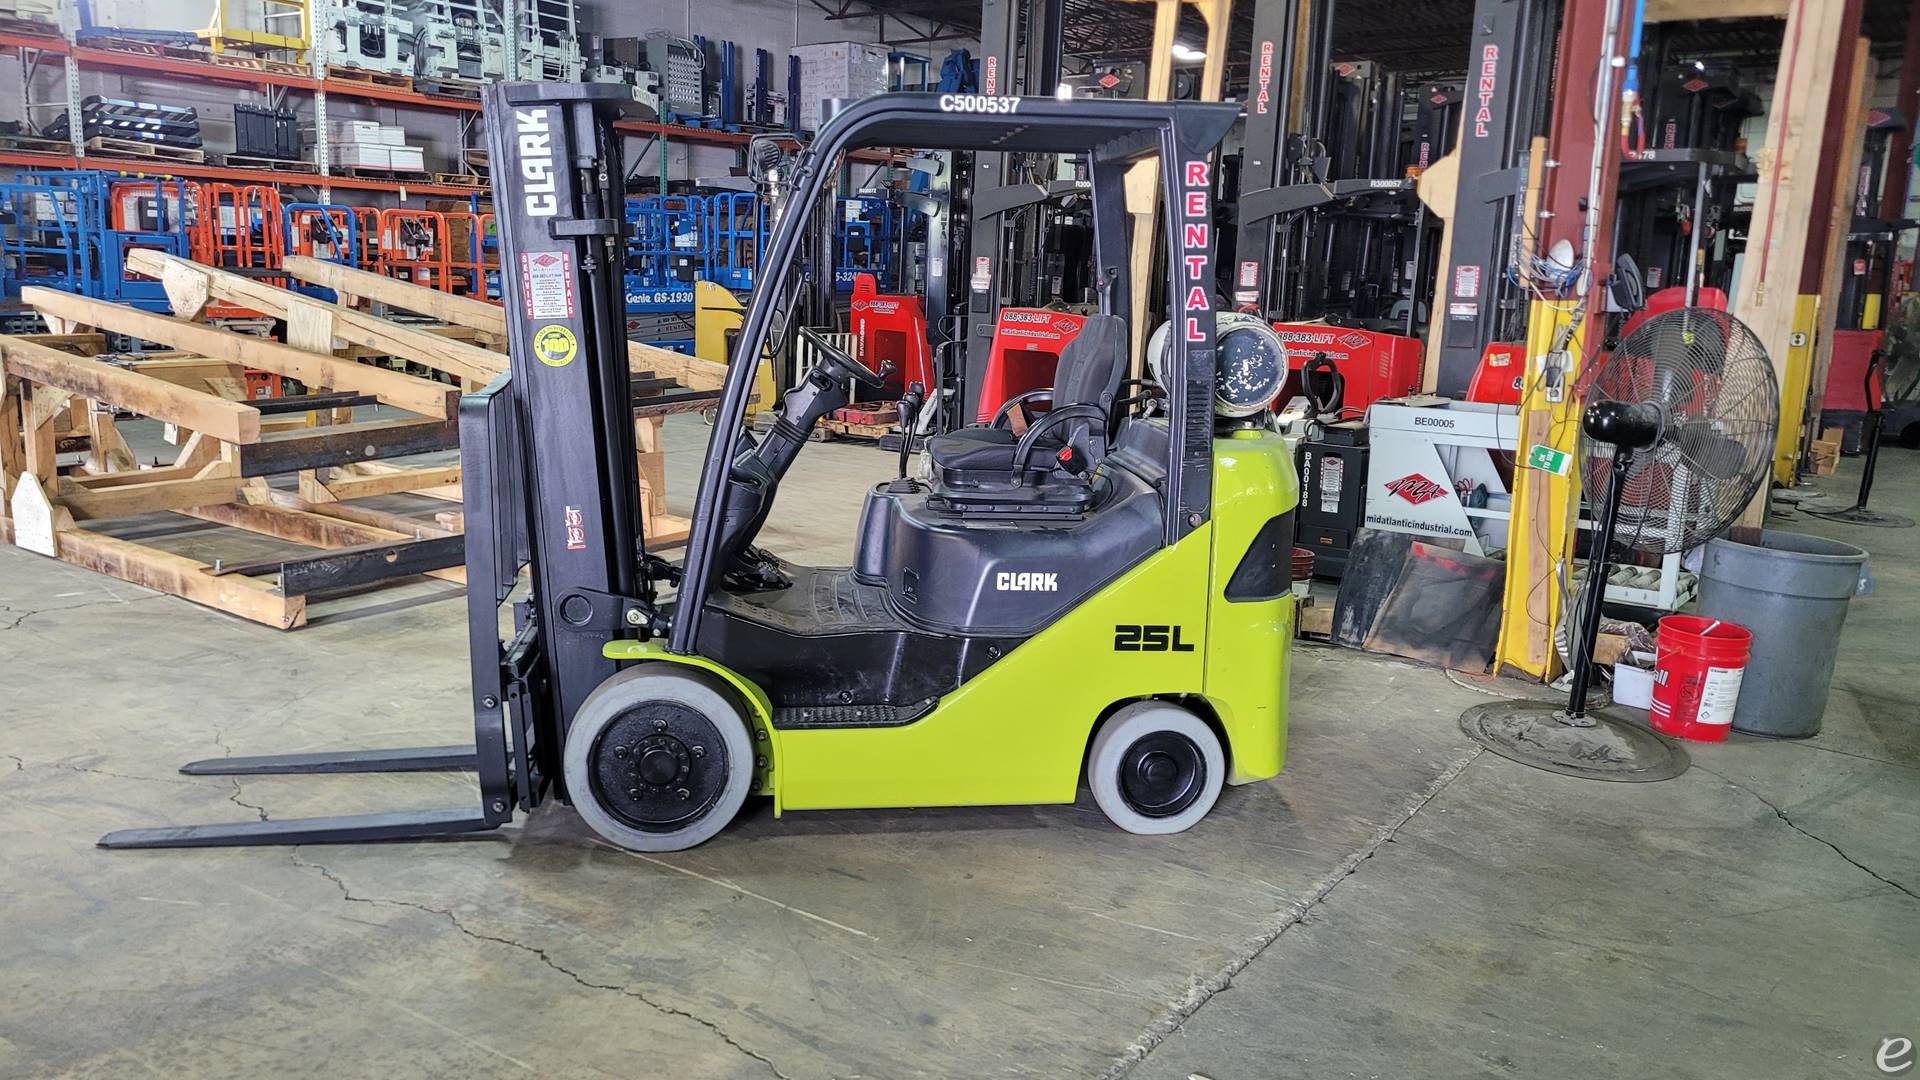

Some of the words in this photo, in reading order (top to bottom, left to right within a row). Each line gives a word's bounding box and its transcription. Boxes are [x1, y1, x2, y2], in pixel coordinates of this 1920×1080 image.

[986, 56, 997, 96] RENT
[1257, 41, 1273, 114] RENTAL
[1475, 44, 1499, 137] RENTAL
[940, 94, 1021, 113] C500537
[516, 109, 558, 217] CLARK
[1419, 142, 1430, 168] REN
[1185, 161, 1209, 342] RENTAL
[521, 254, 534, 317] SERVICE
[562, 253, 574, 315] RENTALS
[626, 293, 651, 304] Genie
[654, 292, 694, 303] GS-1930
[1414, 416, 1455, 428] BE00005
[1301, 451, 1312, 508] BA00188
[1366, 514, 1473, 537] midatlanticindustrial.com
[996, 572, 1058, 592] CLARK
[1114, 625, 1195, 652] 25L
